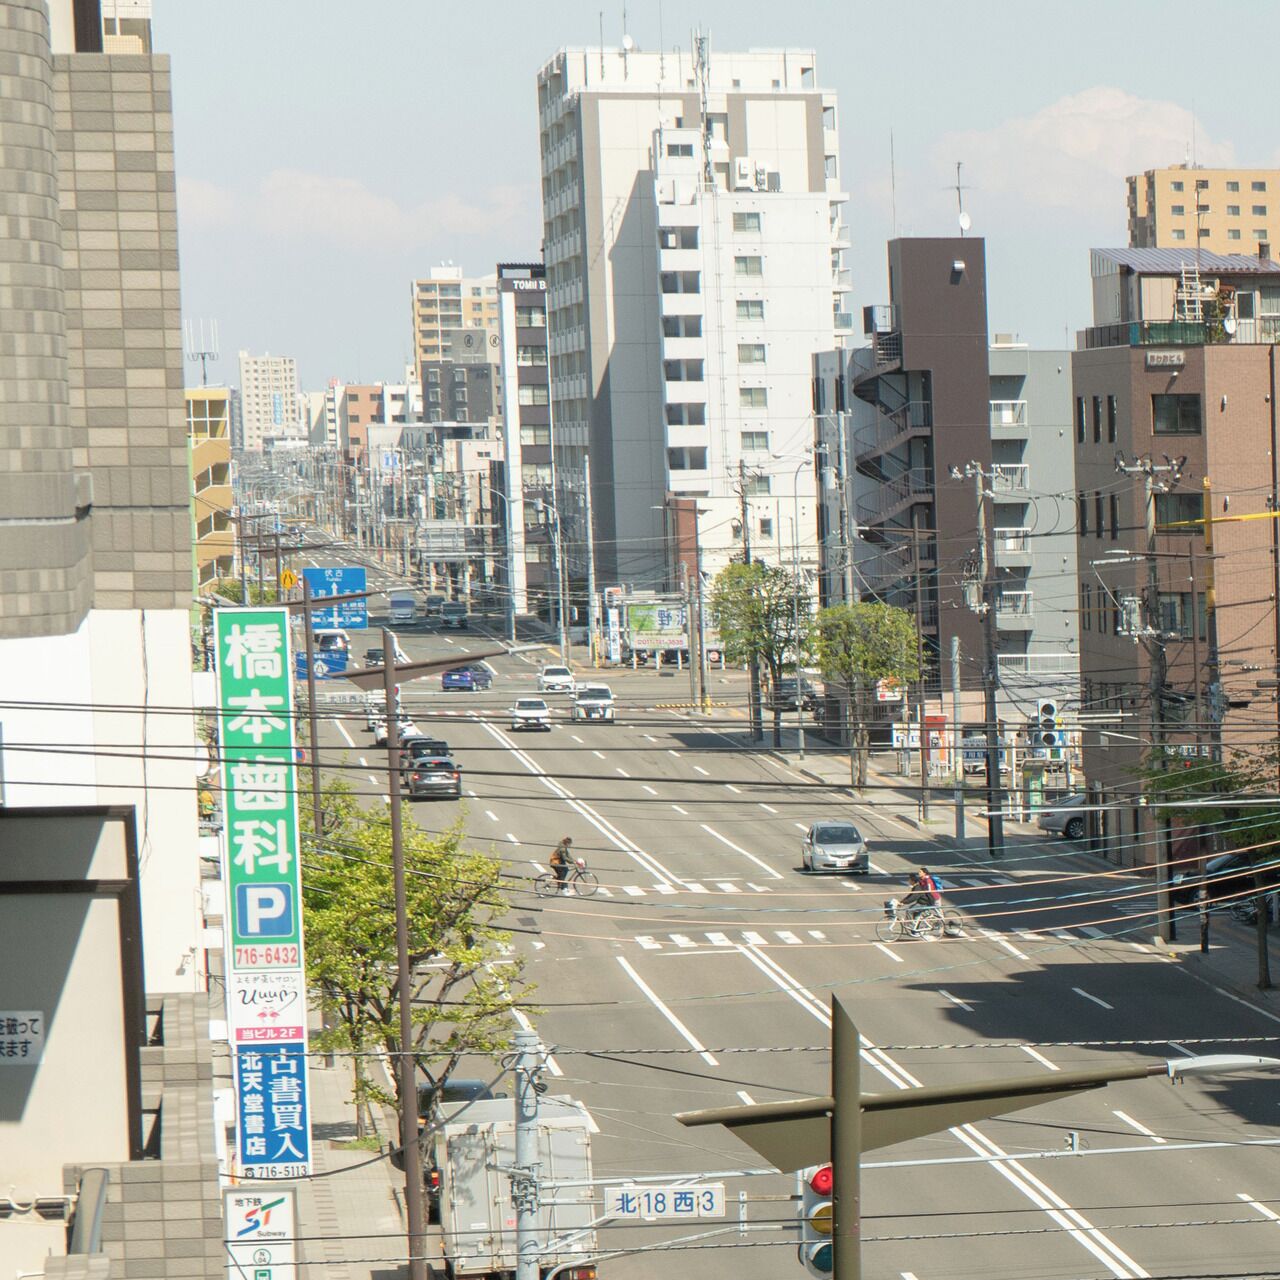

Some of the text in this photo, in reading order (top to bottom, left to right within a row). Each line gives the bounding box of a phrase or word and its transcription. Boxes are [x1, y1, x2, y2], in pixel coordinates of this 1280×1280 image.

[224, 624, 292, 875] 橋本歯科
[246, 887, 286, 934] P
[236, 947, 298, 965] 716-6432
[242, 1028, 297, 1040] 当ビル 2F
[241, 1051, 267, 1157] 北天堂書店
[268, 1048, 305, 1160] 古書買入
[258, 1166, 307, 1178] 716-5113
[235, 1198, 262, 1207] 地下鉄
[257, 1230, 287, 1238] Subway
